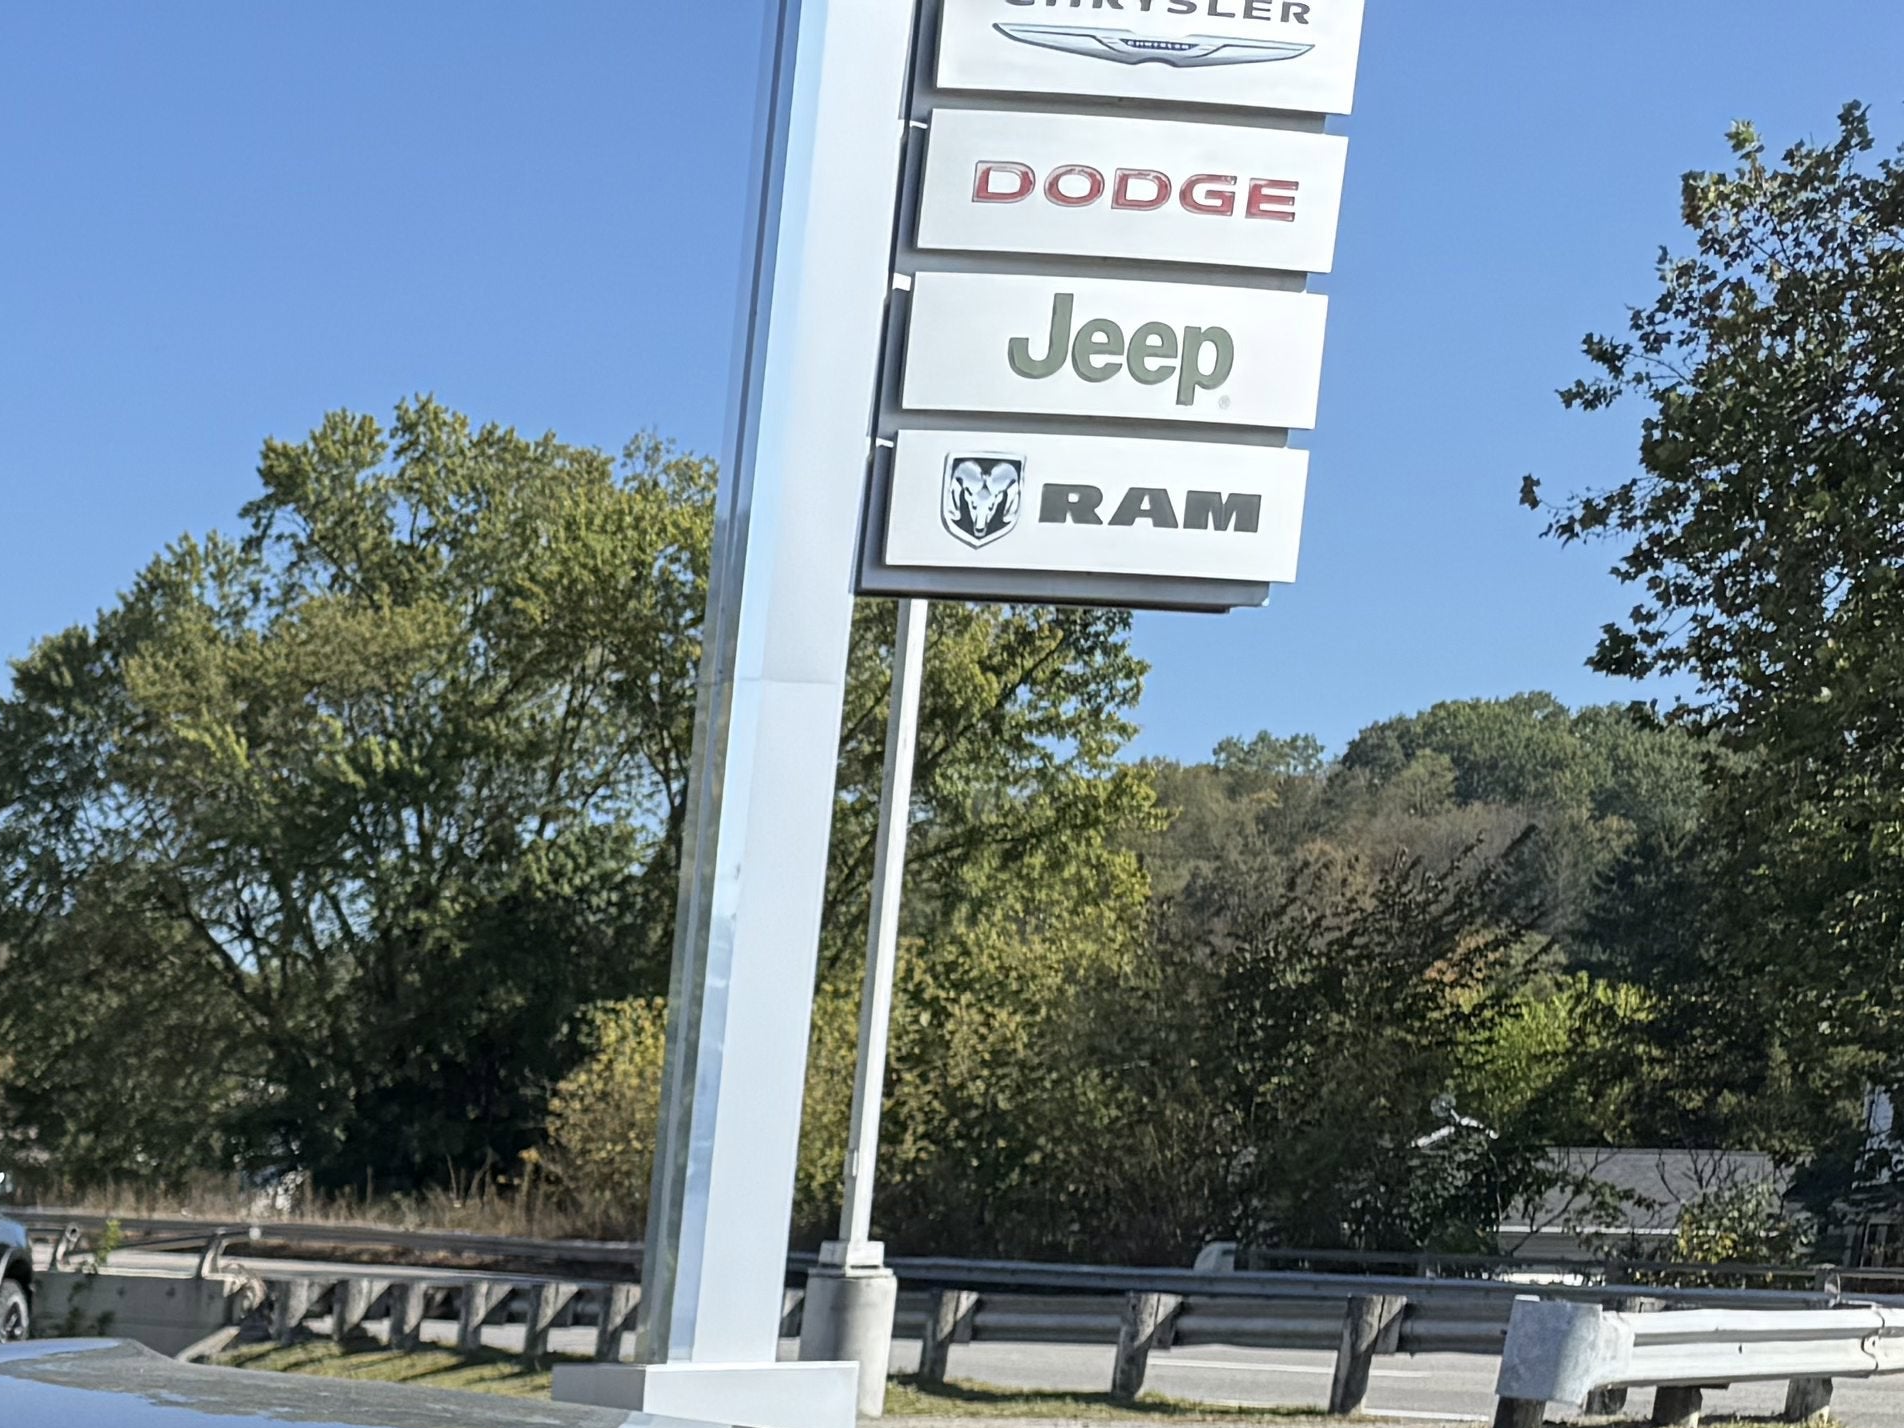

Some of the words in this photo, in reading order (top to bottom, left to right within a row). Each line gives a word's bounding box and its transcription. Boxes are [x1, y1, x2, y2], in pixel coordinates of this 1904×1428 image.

[1005, 0, 1310, 24] YSLER
[971, 160, 1299, 222] DODGE
[1008, 292, 1234, 406] Jeep
[1038, 483, 1262, 533] RAM
